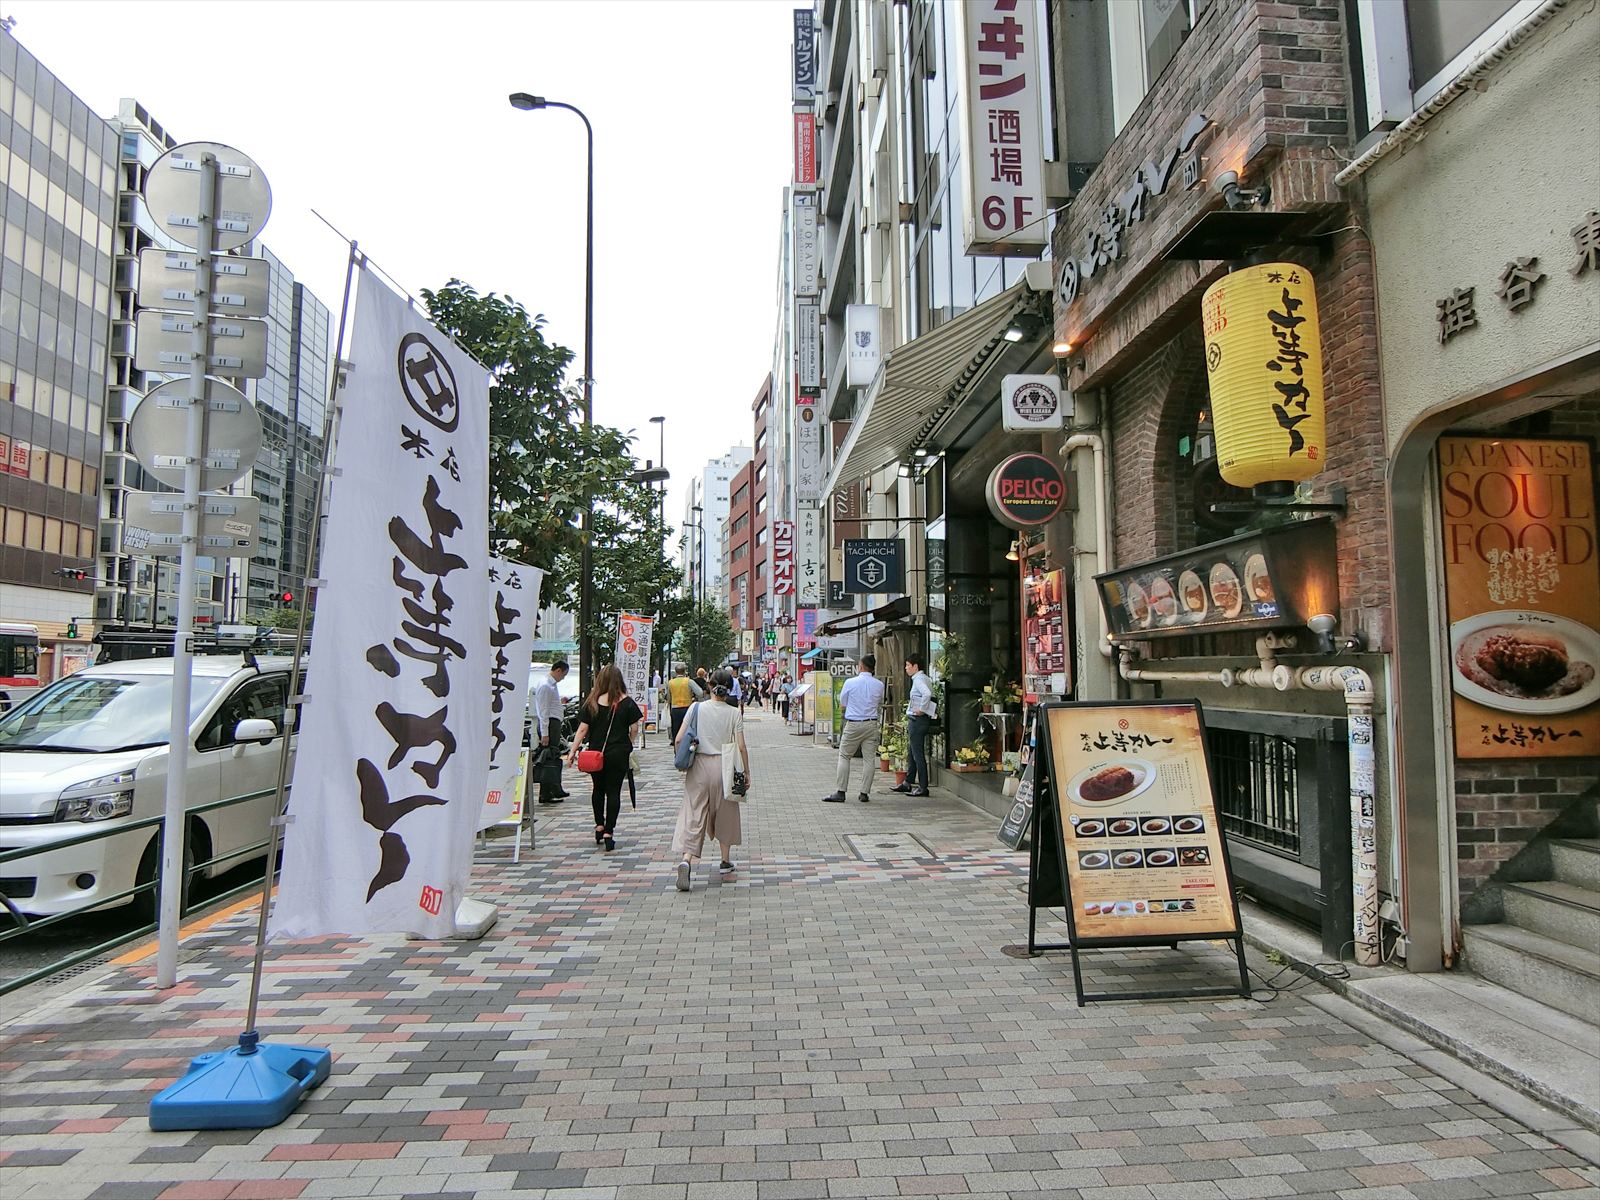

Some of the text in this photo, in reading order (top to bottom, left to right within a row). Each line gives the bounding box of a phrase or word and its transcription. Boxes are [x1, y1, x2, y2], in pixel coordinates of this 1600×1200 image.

[796, 27, 811, 82] ドルフィン
[982, 195, 1033, 231] 6F
[799, 427, 812, 485] ほぐし家
[1442, 443, 1586, 469] JAPANESE
[1001, 477, 1063, 499] BELGO
[1445, 471, 1590, 520] SOUL
[126, 526, 151, 540] WONG
[1446, 523, 1593, 565] FOOD
[775, 521, 792, 595] カラオケ
[803, 611, 815, 635] 白衣
[635, 623, 649, 702] 交通事故の痛み
[830, 664, 859, 676] OPEN
[1093, 730, 1175, 753] 上等カレー
[1492, 723, 1583, 748] 上等カレー
